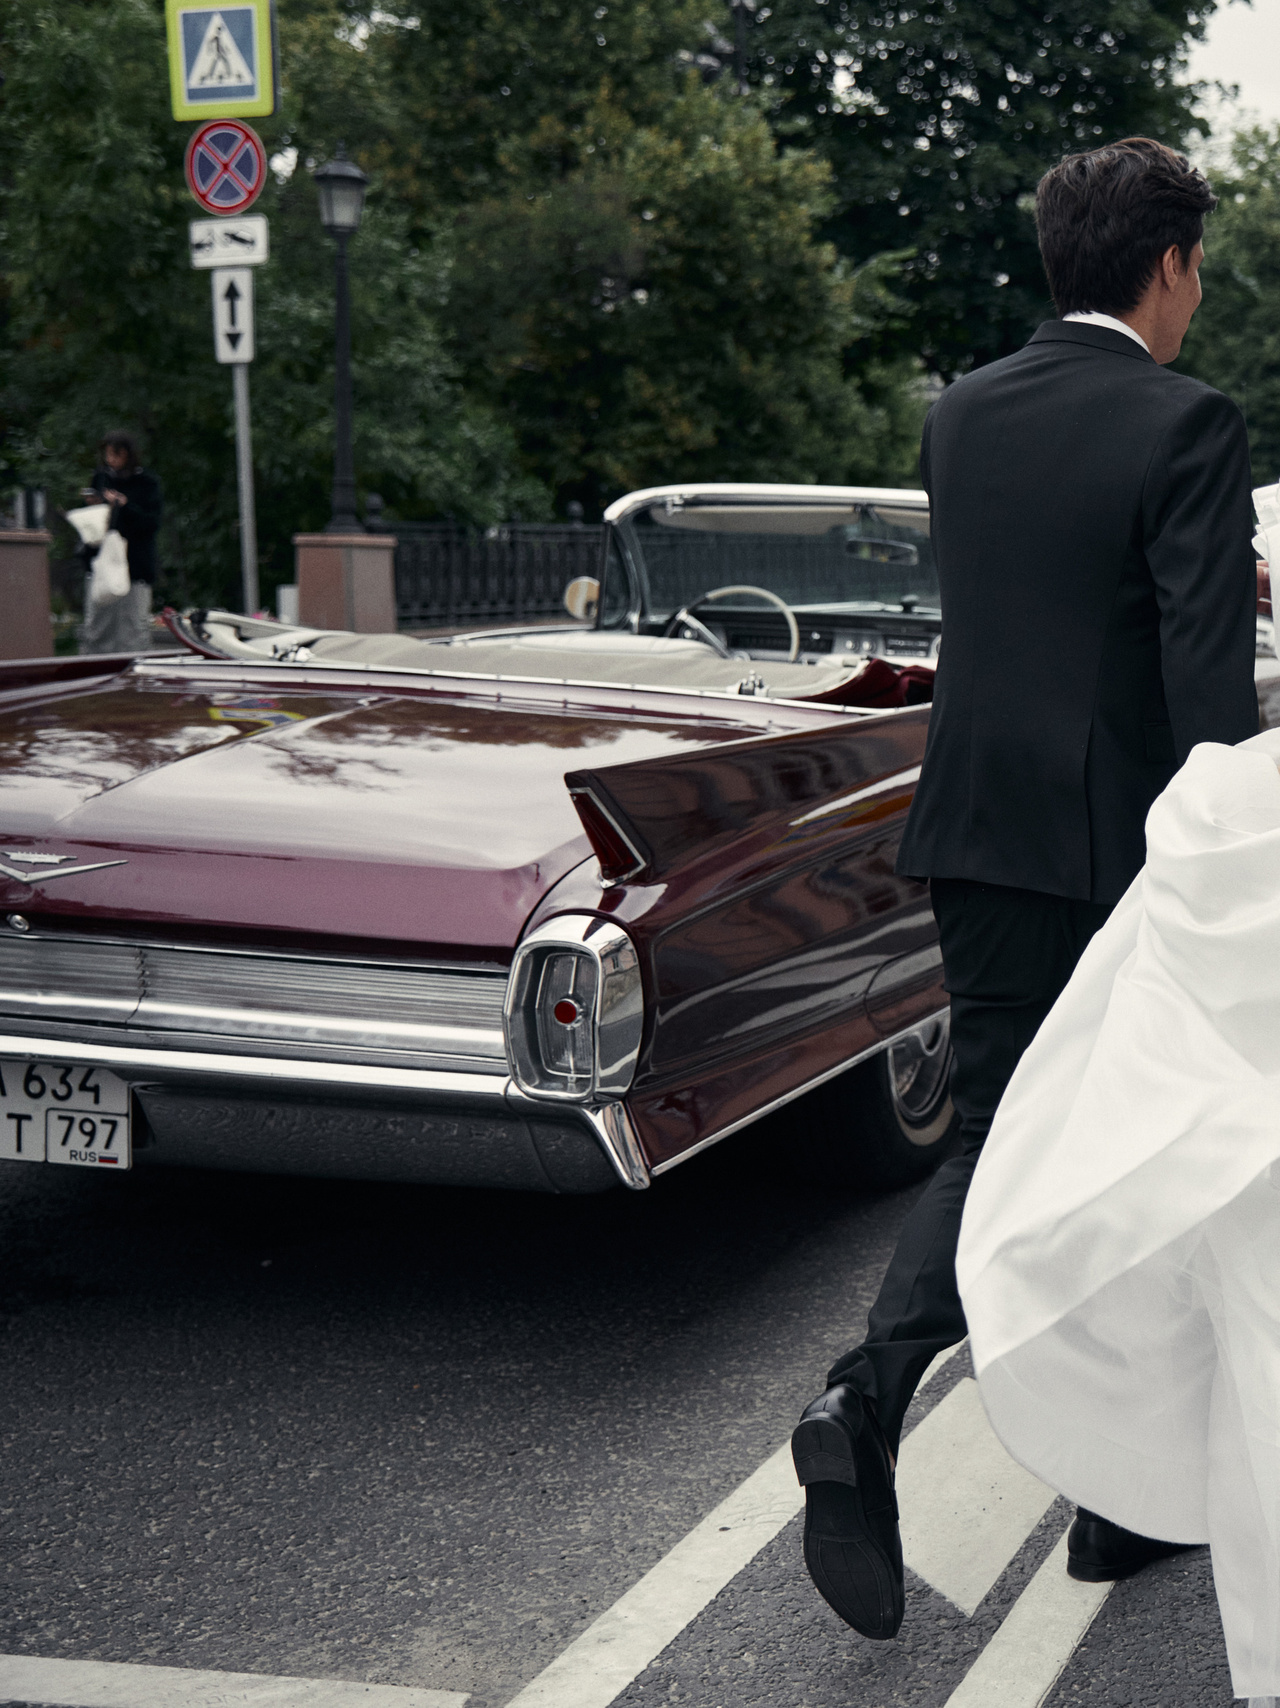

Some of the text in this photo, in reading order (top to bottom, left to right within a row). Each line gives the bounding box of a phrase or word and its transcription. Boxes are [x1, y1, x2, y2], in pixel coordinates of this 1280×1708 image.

[23, 1064, 101, 1105] 634
[57, 1114, 118, 1150] 797
[69, 1149, 98, 1163] RUS
